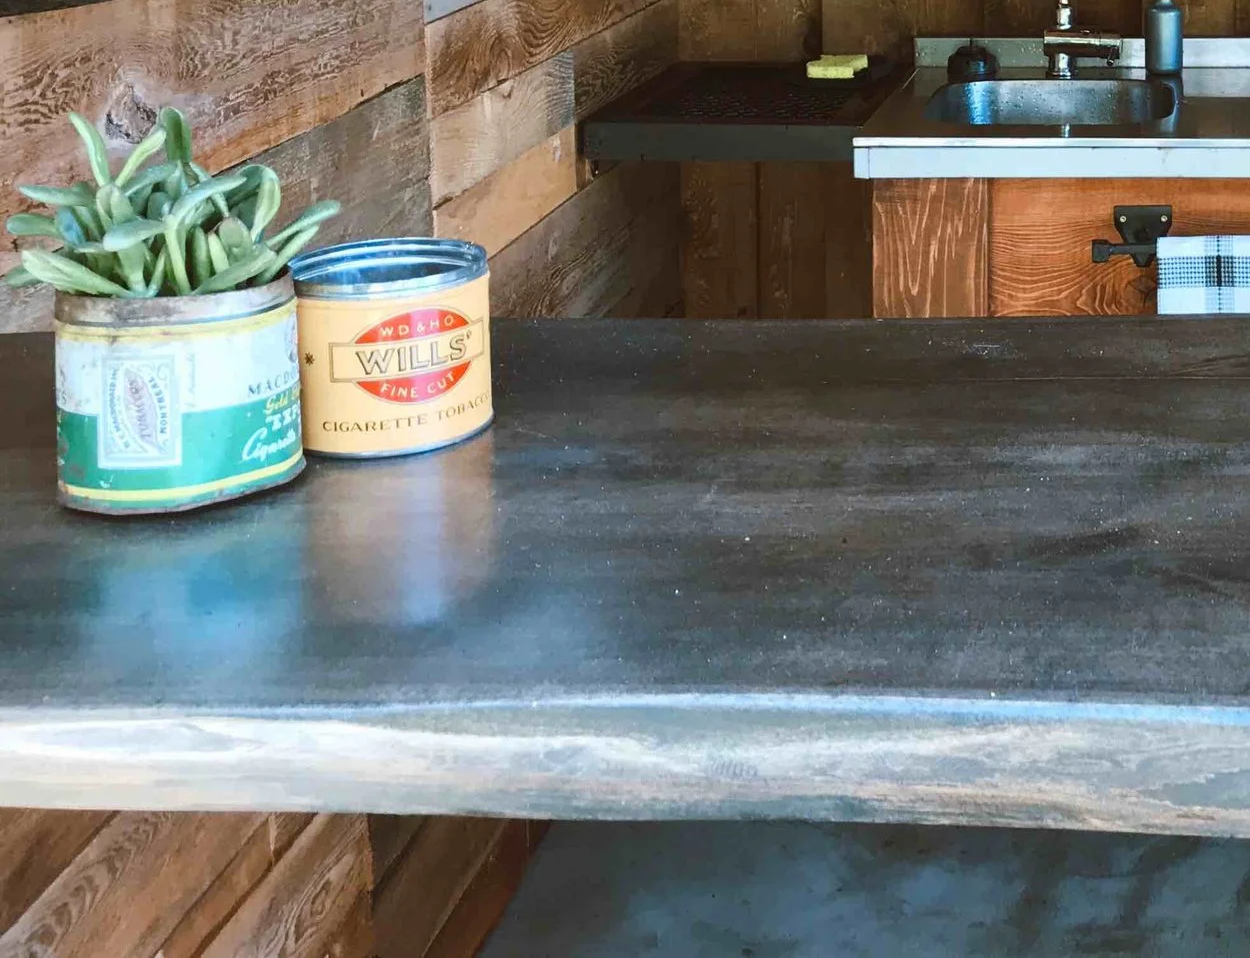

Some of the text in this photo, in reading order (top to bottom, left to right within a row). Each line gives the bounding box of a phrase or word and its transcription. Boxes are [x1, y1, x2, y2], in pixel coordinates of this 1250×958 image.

[380, 370, 456, 399] FINE CUT
[148, 376, 168, 434] MONTREAL
[322, 413, 428, 434] CIGARETTE
